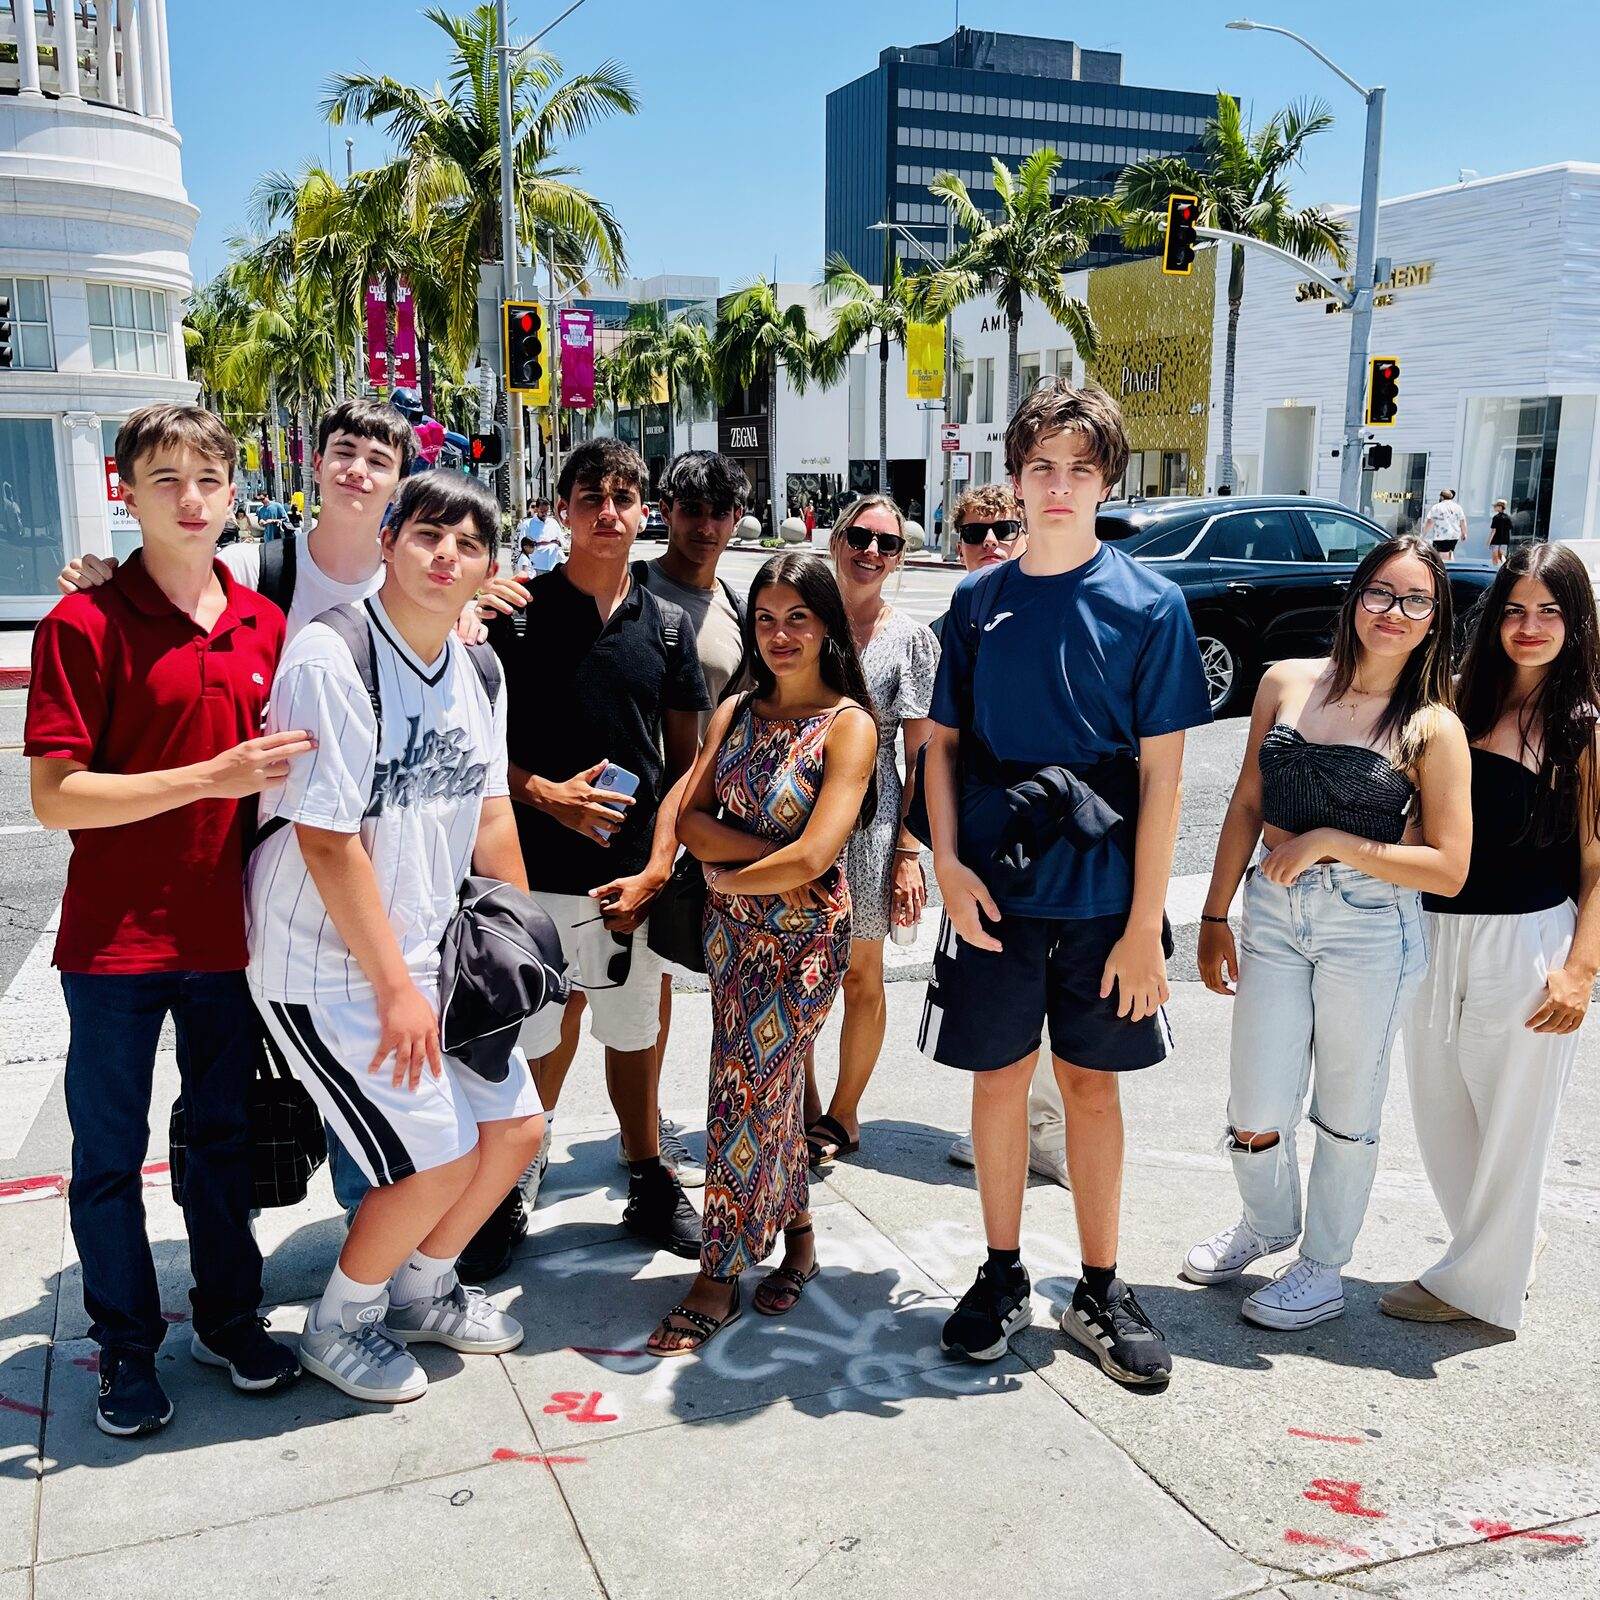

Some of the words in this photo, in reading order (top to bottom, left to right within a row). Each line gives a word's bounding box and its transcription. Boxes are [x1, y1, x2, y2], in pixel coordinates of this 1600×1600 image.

[980, 313, 1023, 333] AMII
[1121, 363, 1163, 397] PIAGET
[730, 426, 759, 448] ZEGNA
